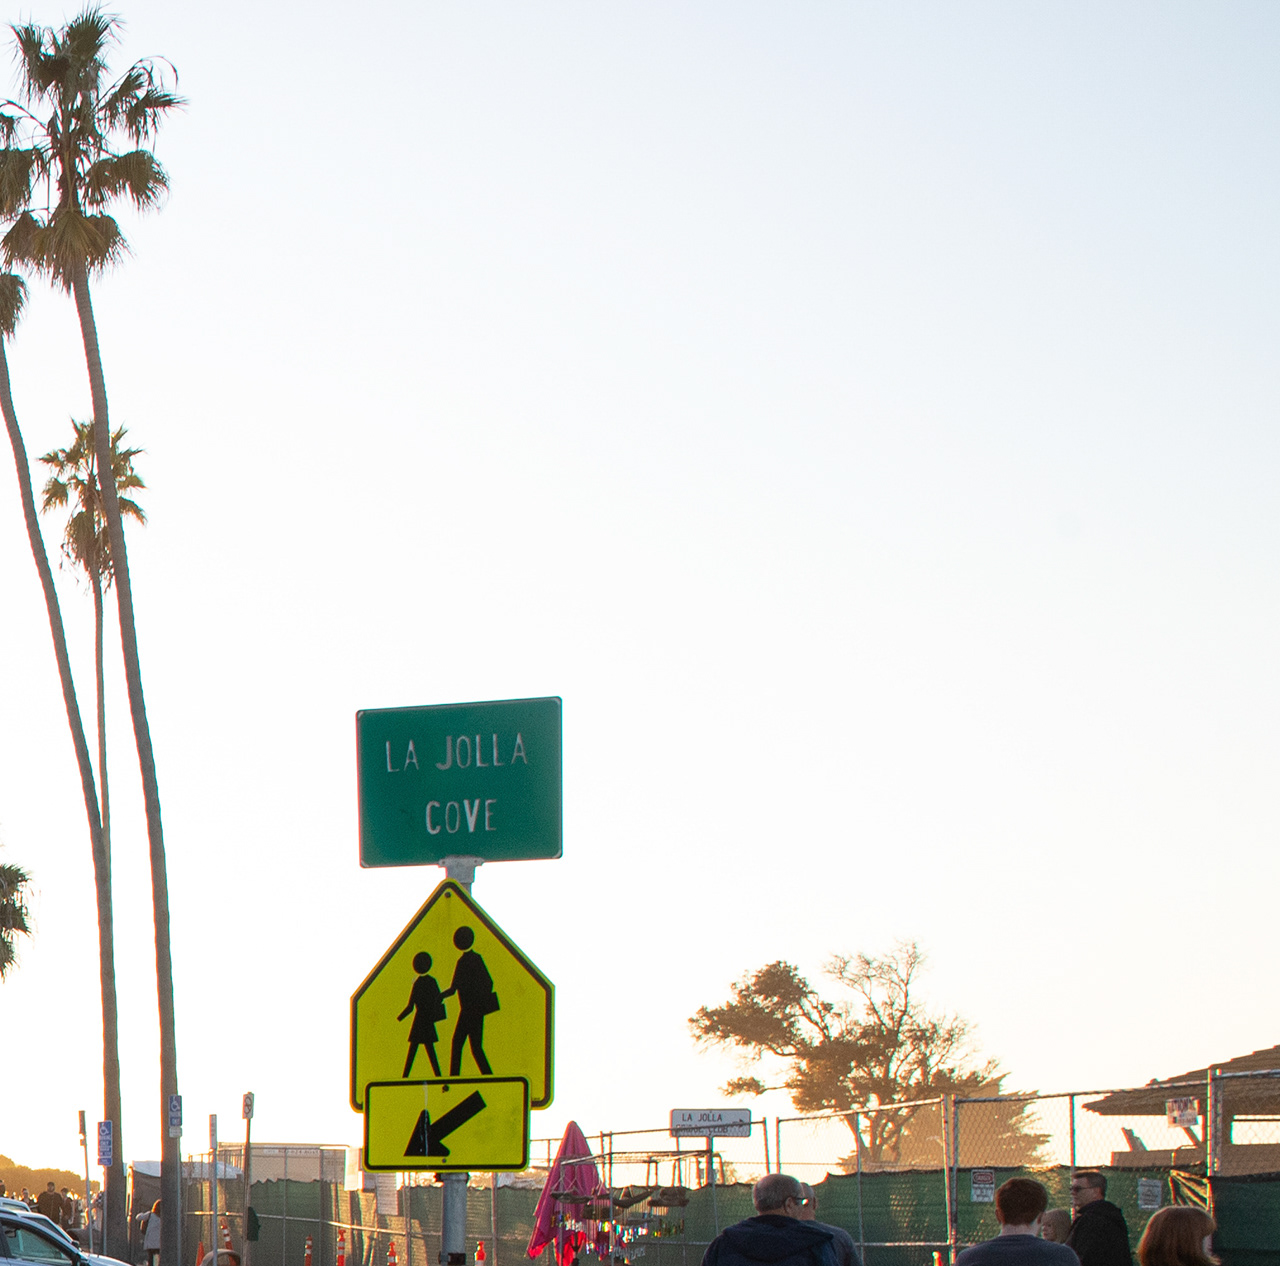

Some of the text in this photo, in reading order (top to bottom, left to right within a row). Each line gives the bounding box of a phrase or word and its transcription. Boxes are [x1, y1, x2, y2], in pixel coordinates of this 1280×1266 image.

[385, 732, 528, 772] LA JOLLA
[425, 798, 497, 835] COVE
[681, 1113, 723, 1122] LA JOLLA
